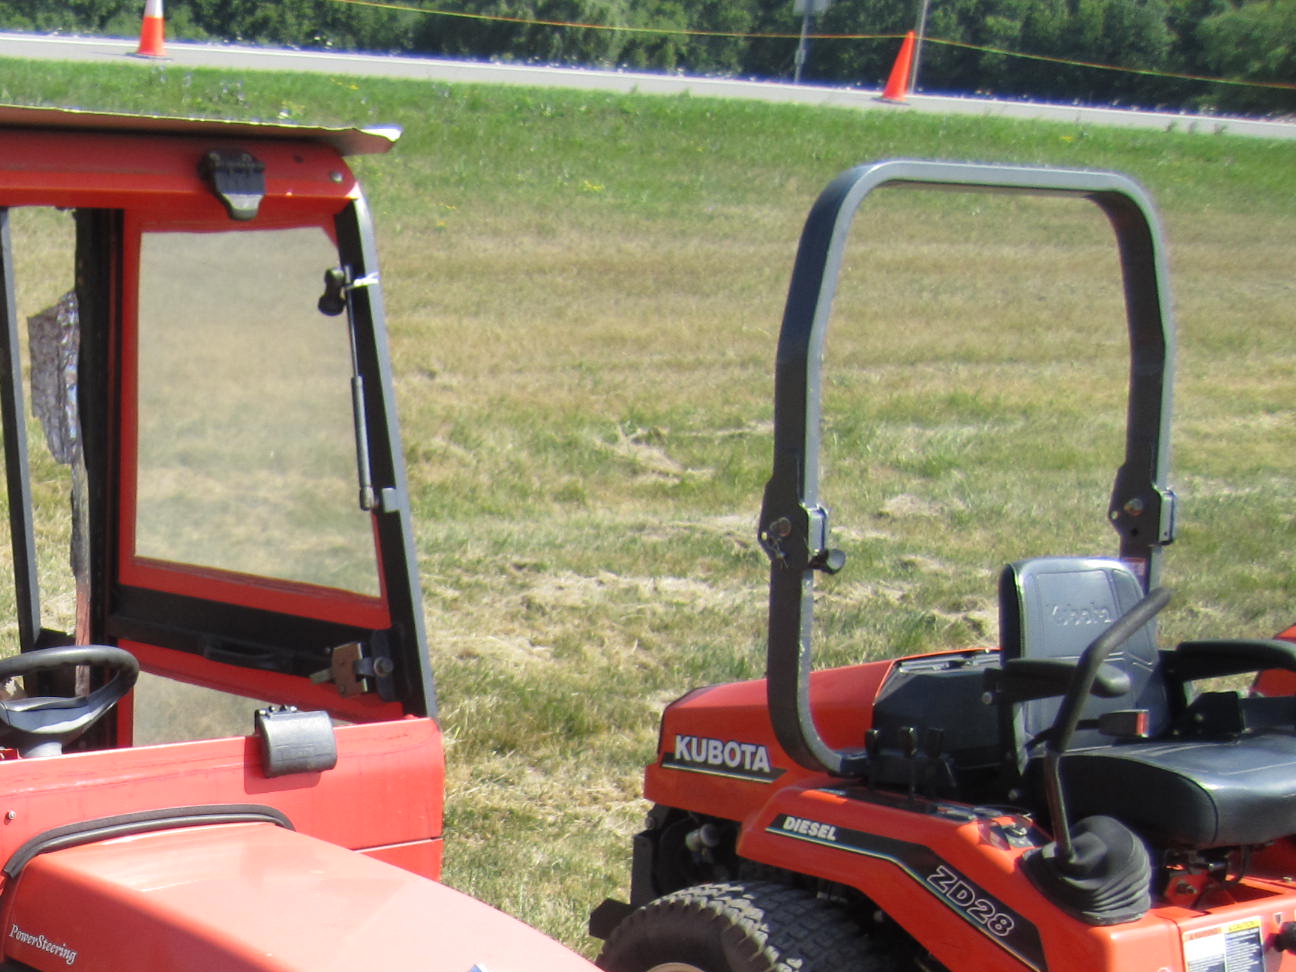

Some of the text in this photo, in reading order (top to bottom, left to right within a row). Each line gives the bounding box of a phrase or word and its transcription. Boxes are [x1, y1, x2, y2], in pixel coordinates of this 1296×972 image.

[674, 734, 770, 773] KUBOTA
[782, 816, 836, 841] DIESEL
[926, 865, 1015, 938] ZD28
[8, 924, 78, 965] PowerSteering
